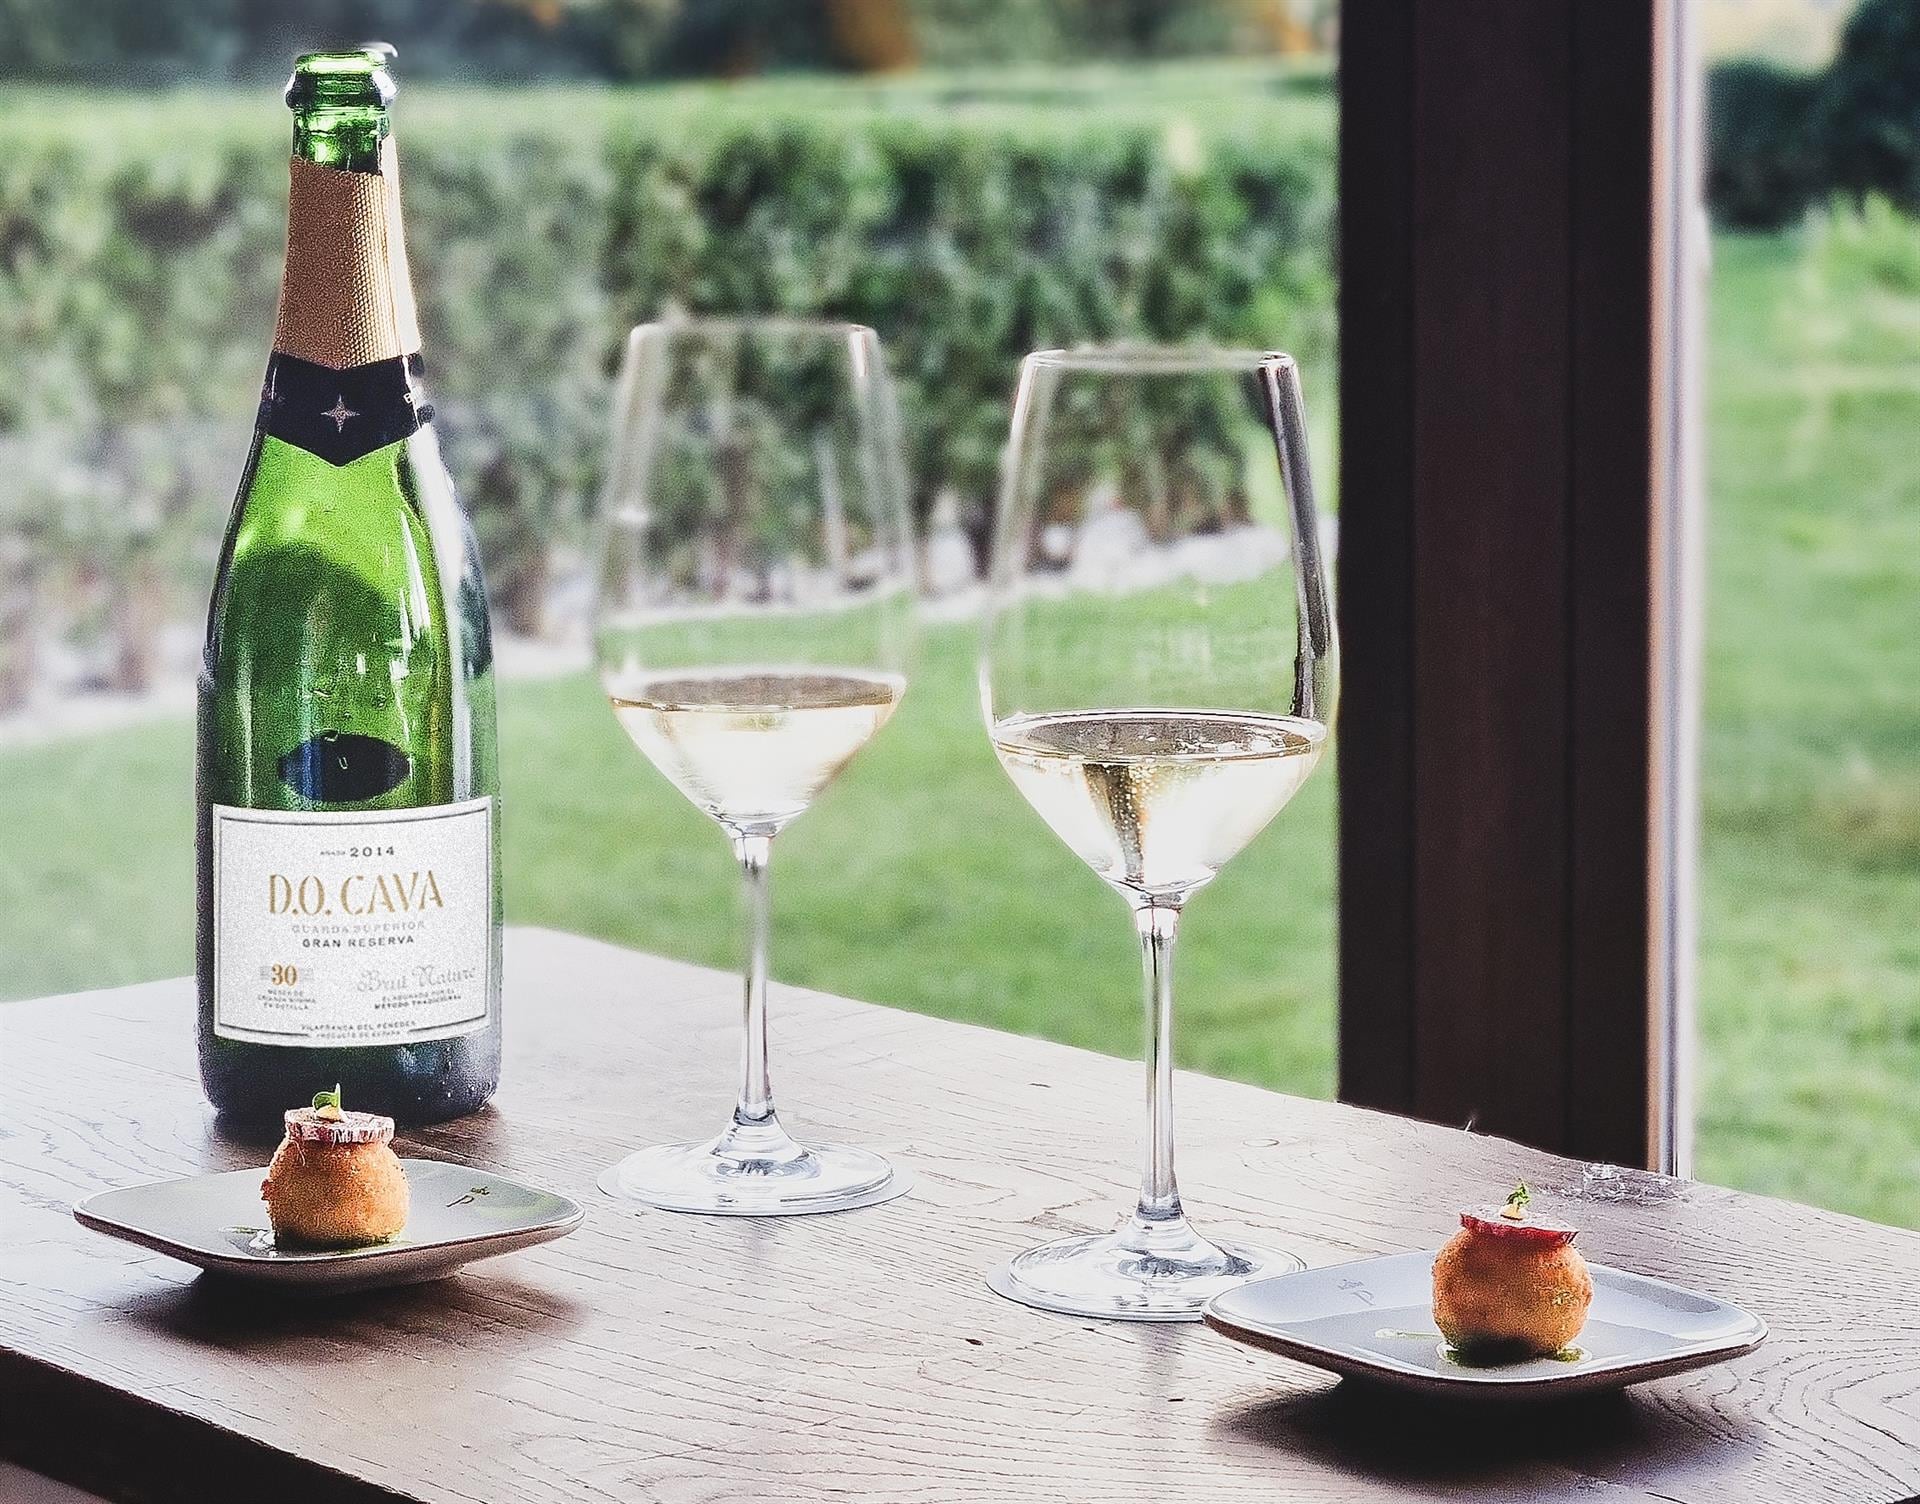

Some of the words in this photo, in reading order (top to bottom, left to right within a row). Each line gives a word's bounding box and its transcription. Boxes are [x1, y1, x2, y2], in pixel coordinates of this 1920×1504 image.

[350, 846, 394, 858] 2014
[269, 873, 333, 916] D.O.
[340, 870, 444, 916] CAVA
[302, 938, 341, 948] GRAN
[348, 935, 414, 948] RESERVA
[271, 963, 297, 986] 30
